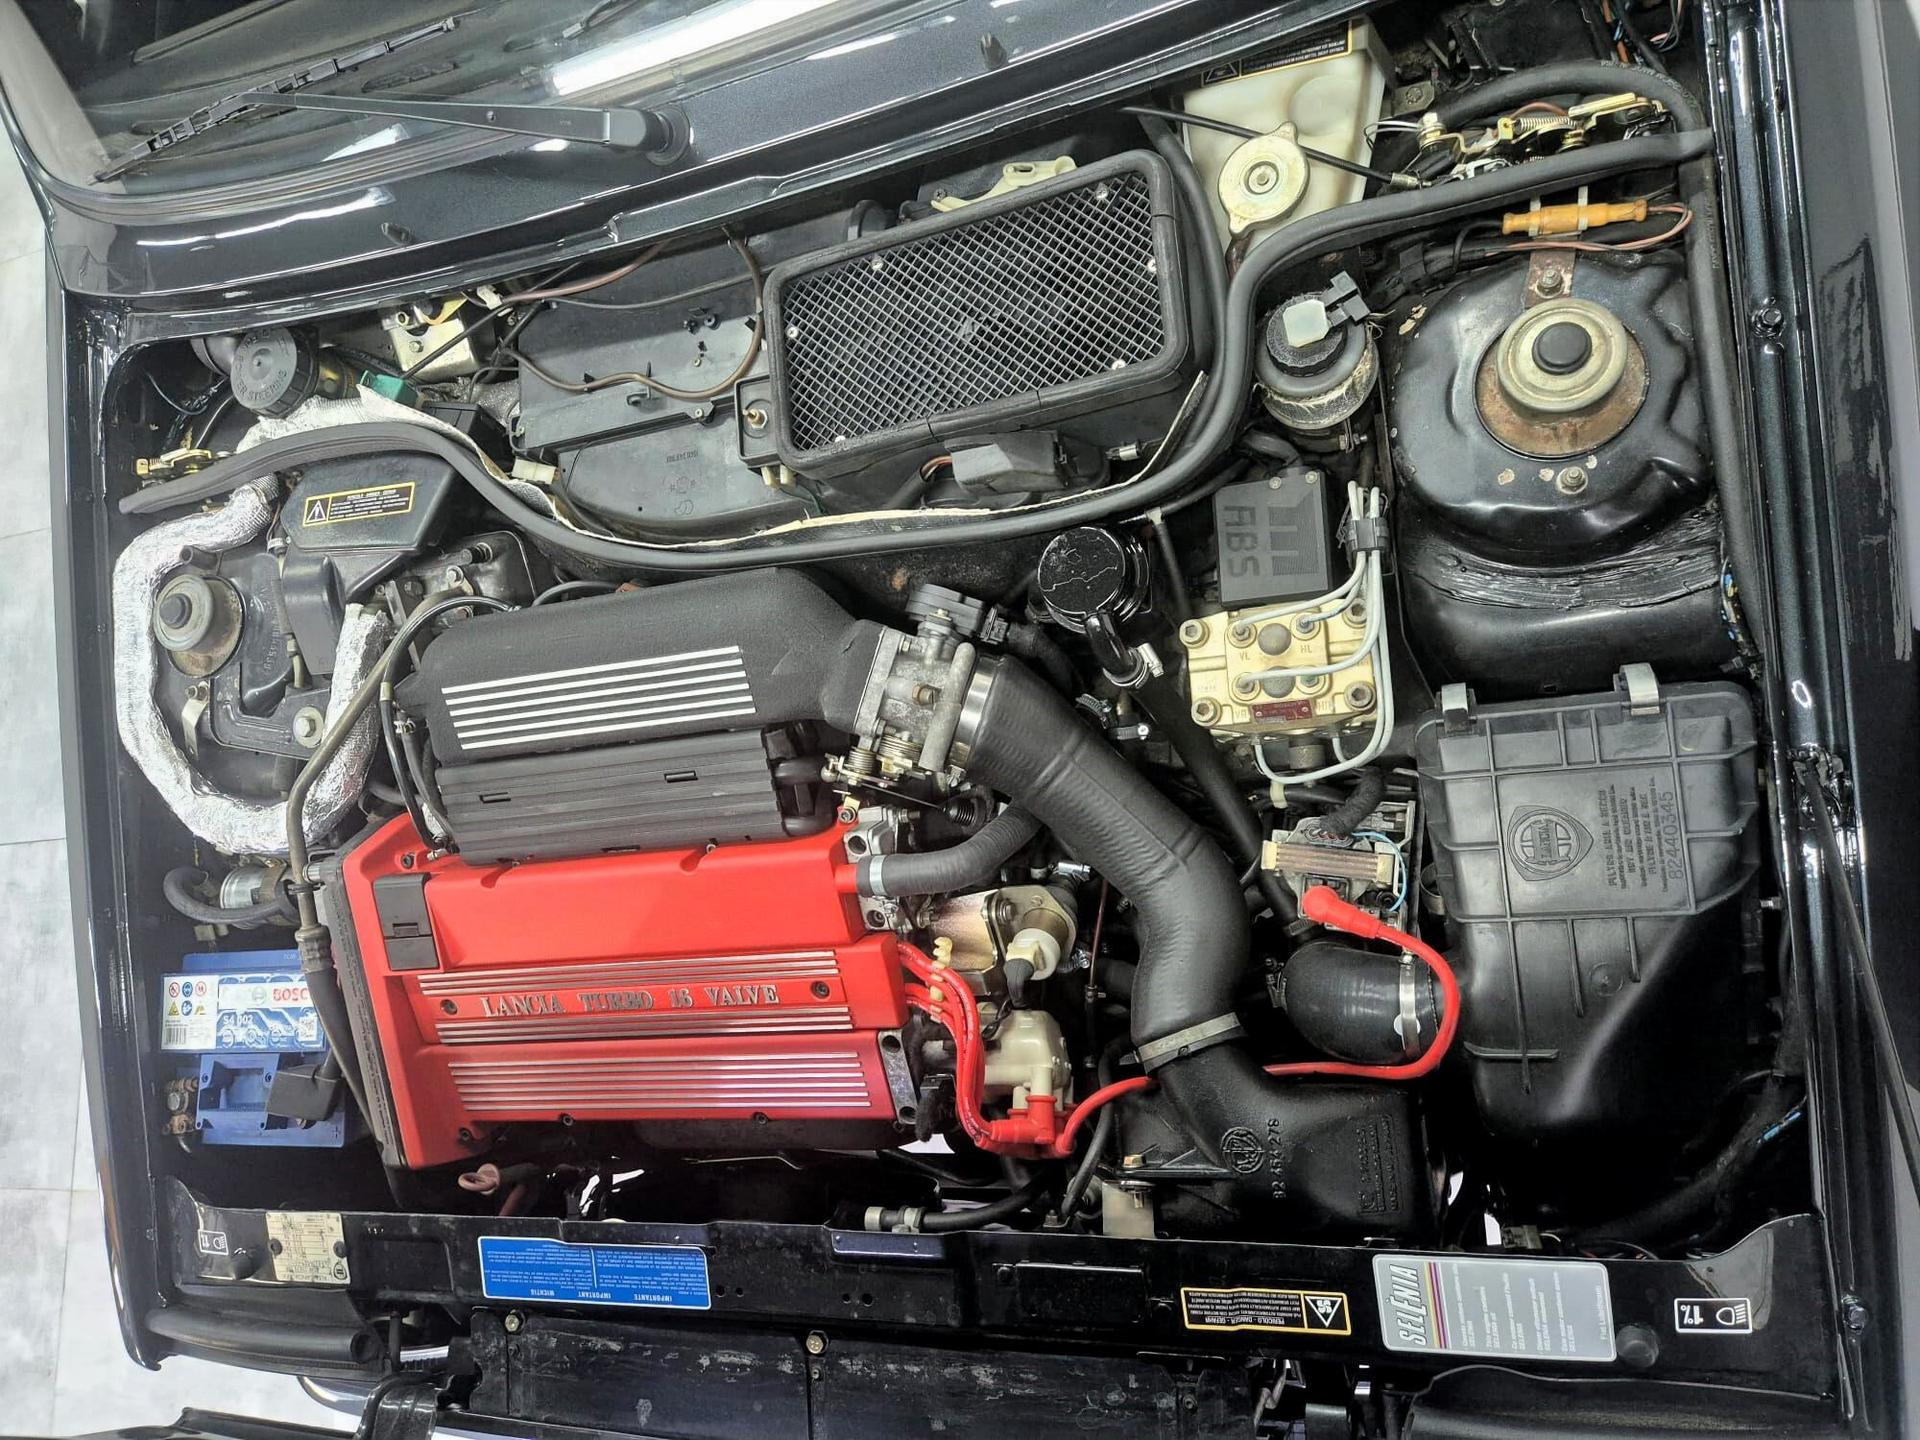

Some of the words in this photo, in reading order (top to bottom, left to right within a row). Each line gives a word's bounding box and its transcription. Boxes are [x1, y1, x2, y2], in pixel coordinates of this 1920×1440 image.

[1224, 505, 1259, 578] ABS
[1658, 791, 1684, 879] 82440345
[273, 987, 309, 1001] BOSC
[480, 993, 566, 1017] LANCIA
[576, 990, 655, 1013] TURBO
[668, 987, 695, 1009] 16
[703, 984, 780, 1007] VALVE
[1266, 1119, 1282, 1146] 278
[530, 1288, 555, 1297] WICHTIG
[578, 1291, 611, 1300] IMPORTANT
[633, 1293, 672, 1302] IMPORTANTE
[1231, 1316, 1253, 1324] DANGER
[1680, 1304, 1704, 1326] 1%
